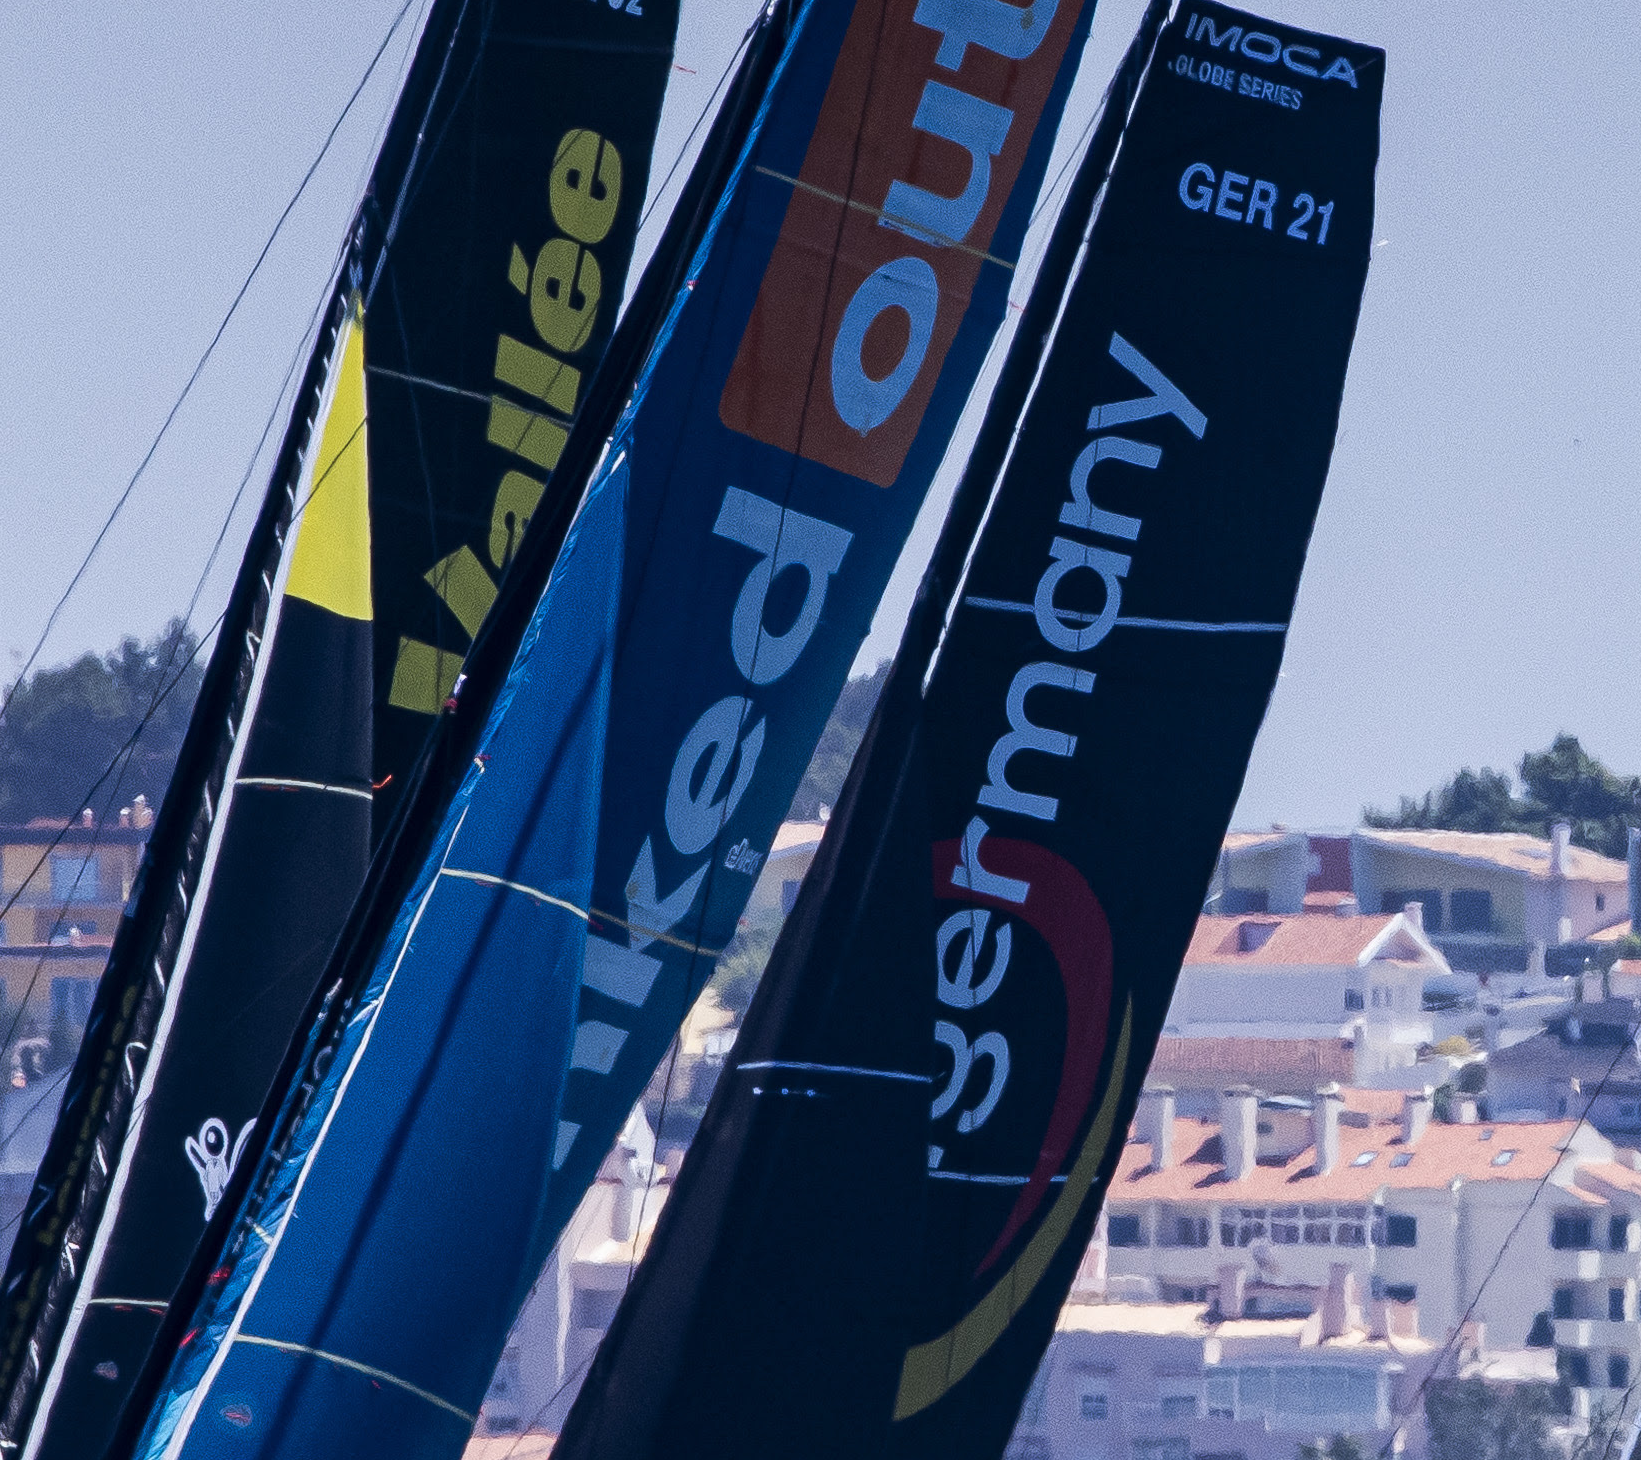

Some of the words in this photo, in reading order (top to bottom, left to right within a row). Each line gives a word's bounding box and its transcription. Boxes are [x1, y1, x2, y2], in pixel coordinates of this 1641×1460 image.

[1174, 53, 1234, 91] GLOBE
[1238, 72, 1304, 110] SERIES
[1184, 12, 1358, 89] IMOCA
[1178, 162, 1279, 230] GER
[1286, 192, 1335, 245] 21
